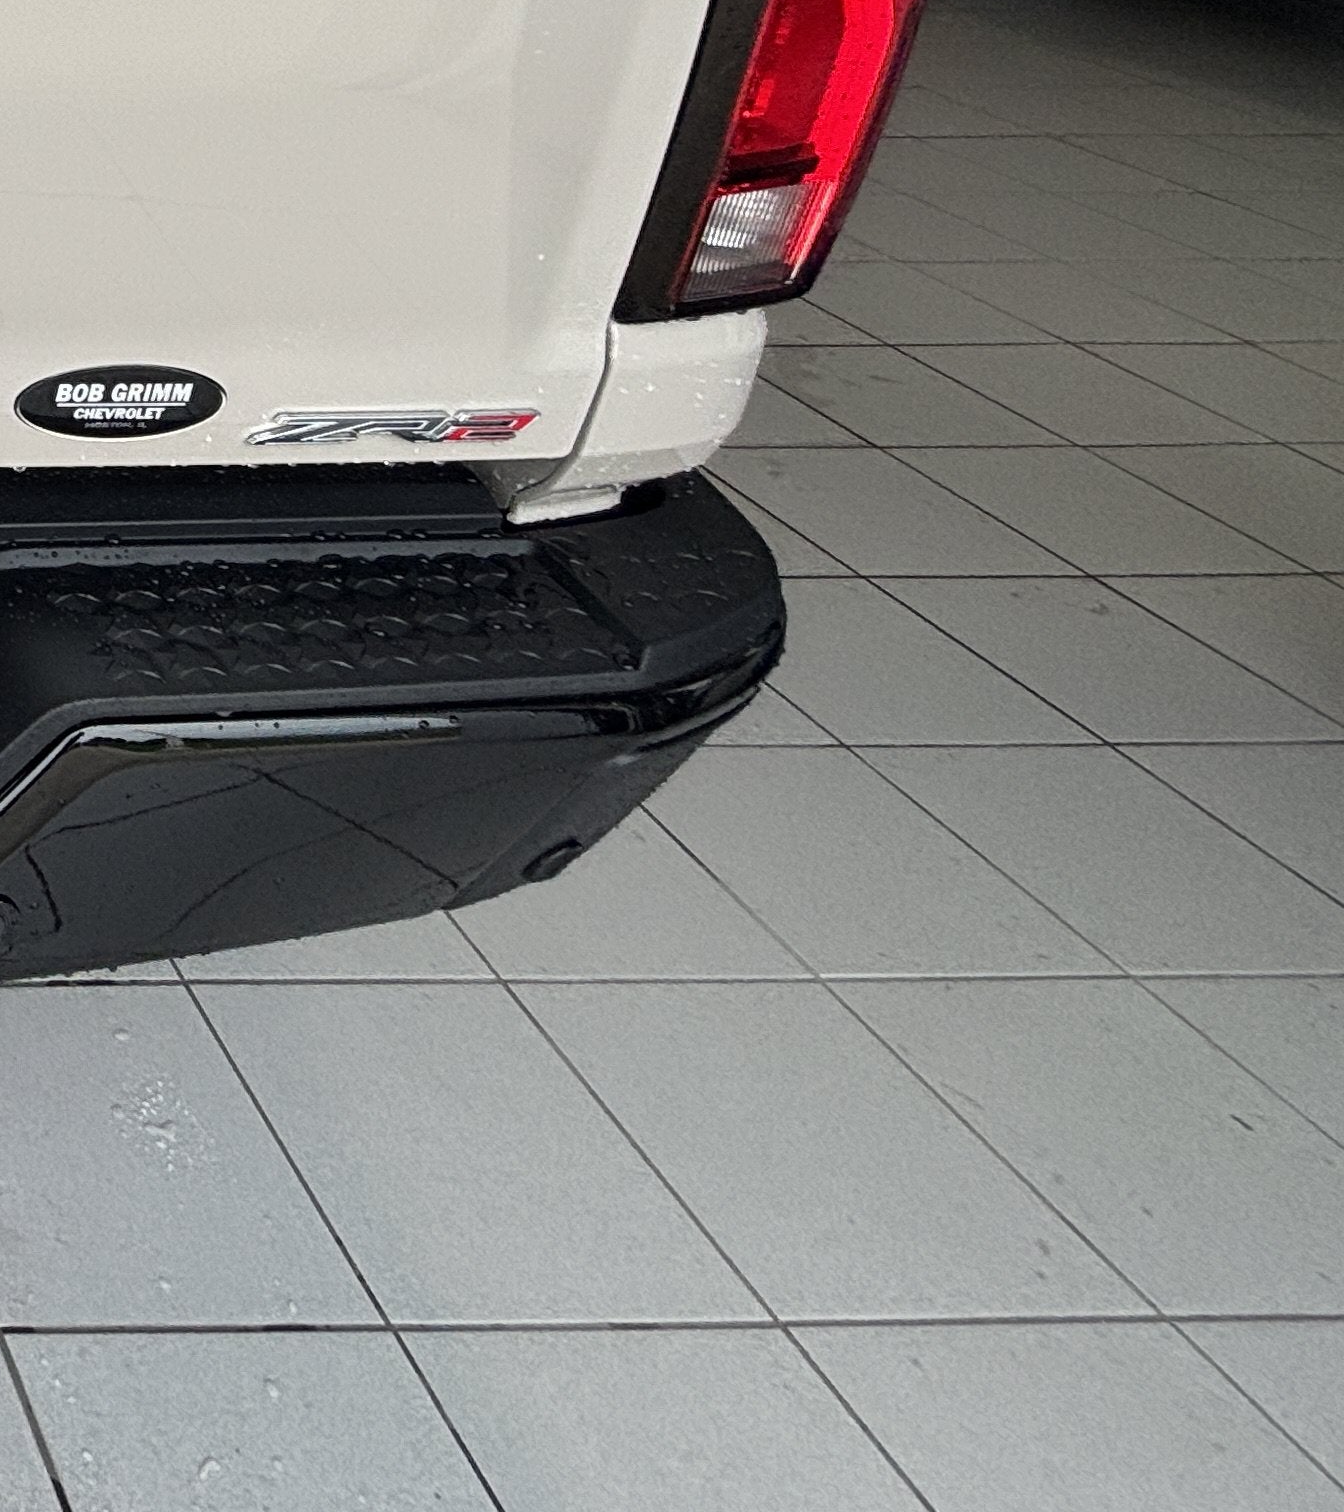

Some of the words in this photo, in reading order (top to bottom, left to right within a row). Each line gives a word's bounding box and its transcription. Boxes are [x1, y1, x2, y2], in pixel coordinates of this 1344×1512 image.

[55, 383, 106, 403] BOB
[110, 382, 194, 403] GRIMM
[72, 407, 167, 421] CHEVROLET
[245, 408, 541, 446] ZR2
